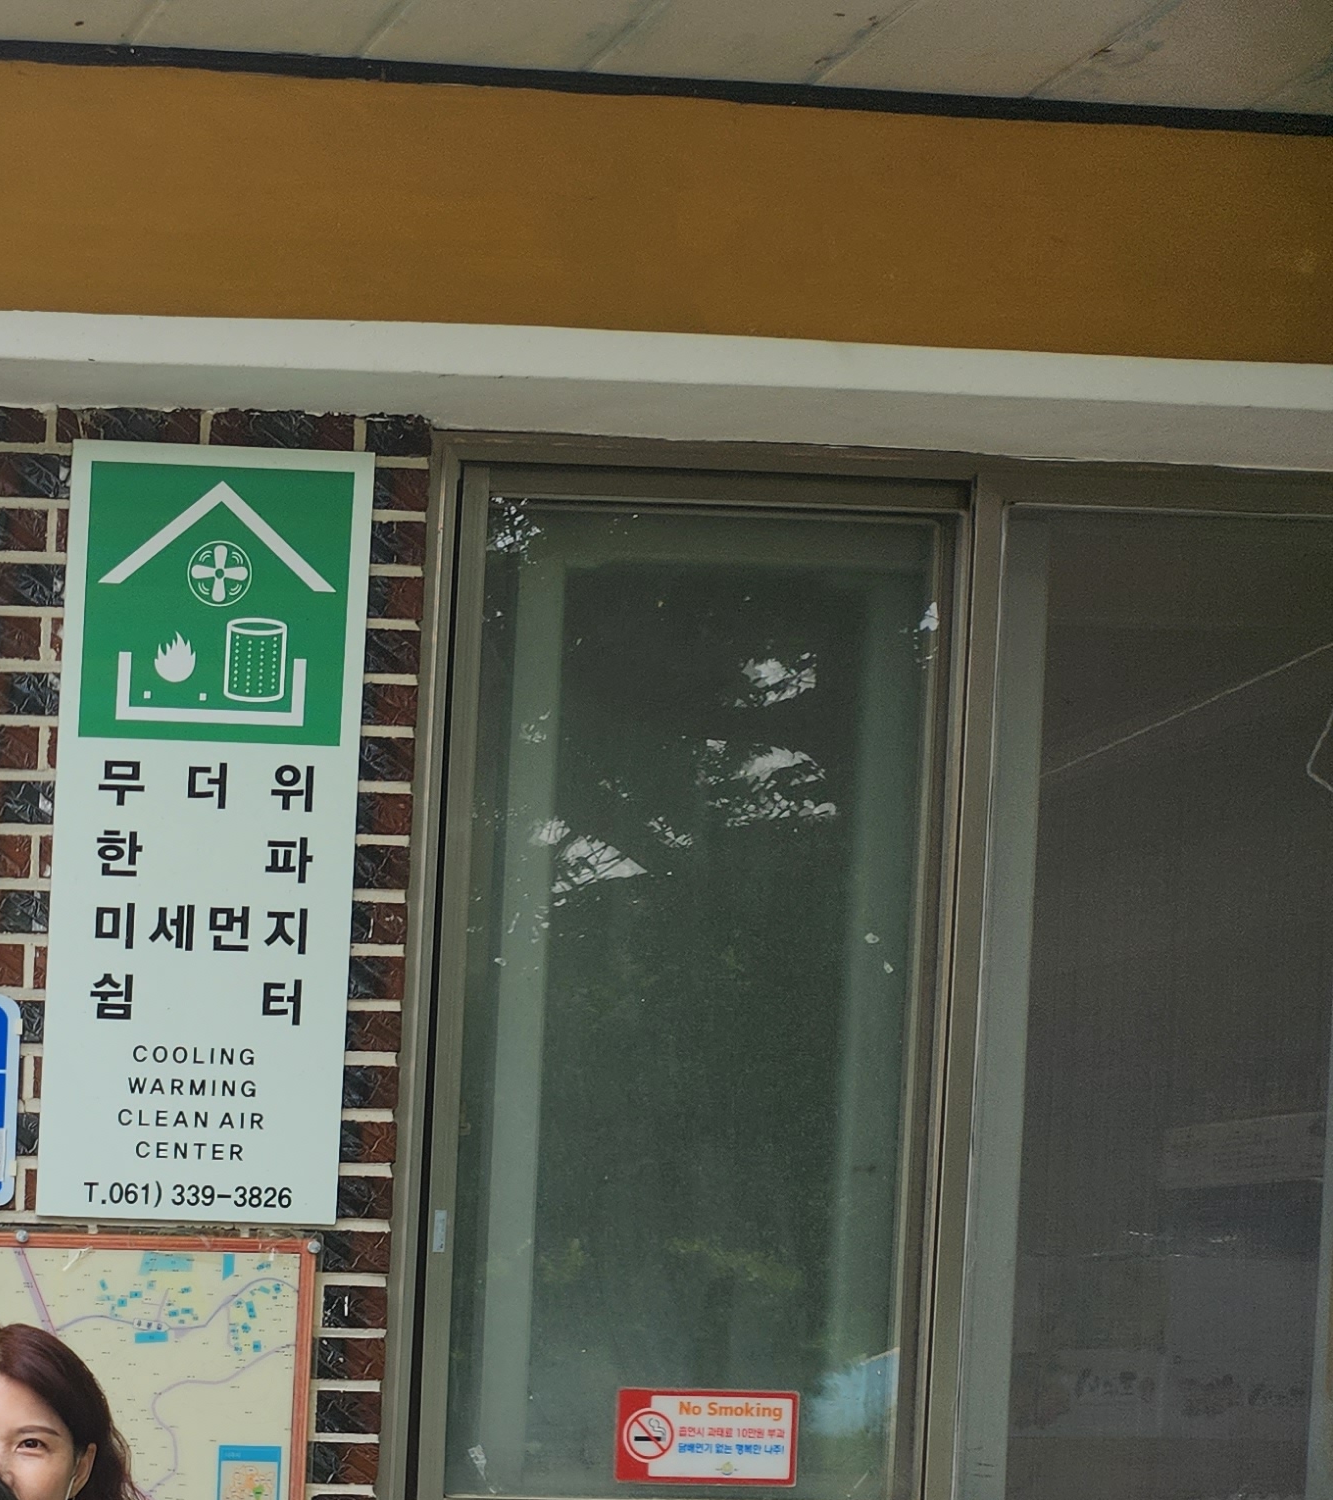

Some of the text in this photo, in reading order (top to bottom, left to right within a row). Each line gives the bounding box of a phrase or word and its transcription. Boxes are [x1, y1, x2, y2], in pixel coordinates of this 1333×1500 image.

[94, 902, 309, 955] 미세먼지
[132, 1045, 256, 1066] COOLING
[128, 1077, 257, 1098] WARMING
[117, 1108, 264, 1130] CLEAN AIR
[135, 1140, 244, 1162] CENTER
[83, 1180, 293, 1209] T.061) 339-3826
[678, 1401, 783, 1421] No Smoking
[707, 1427, 734, 1438] 과태료
[736, 1427, 765, 1439] 10만원
